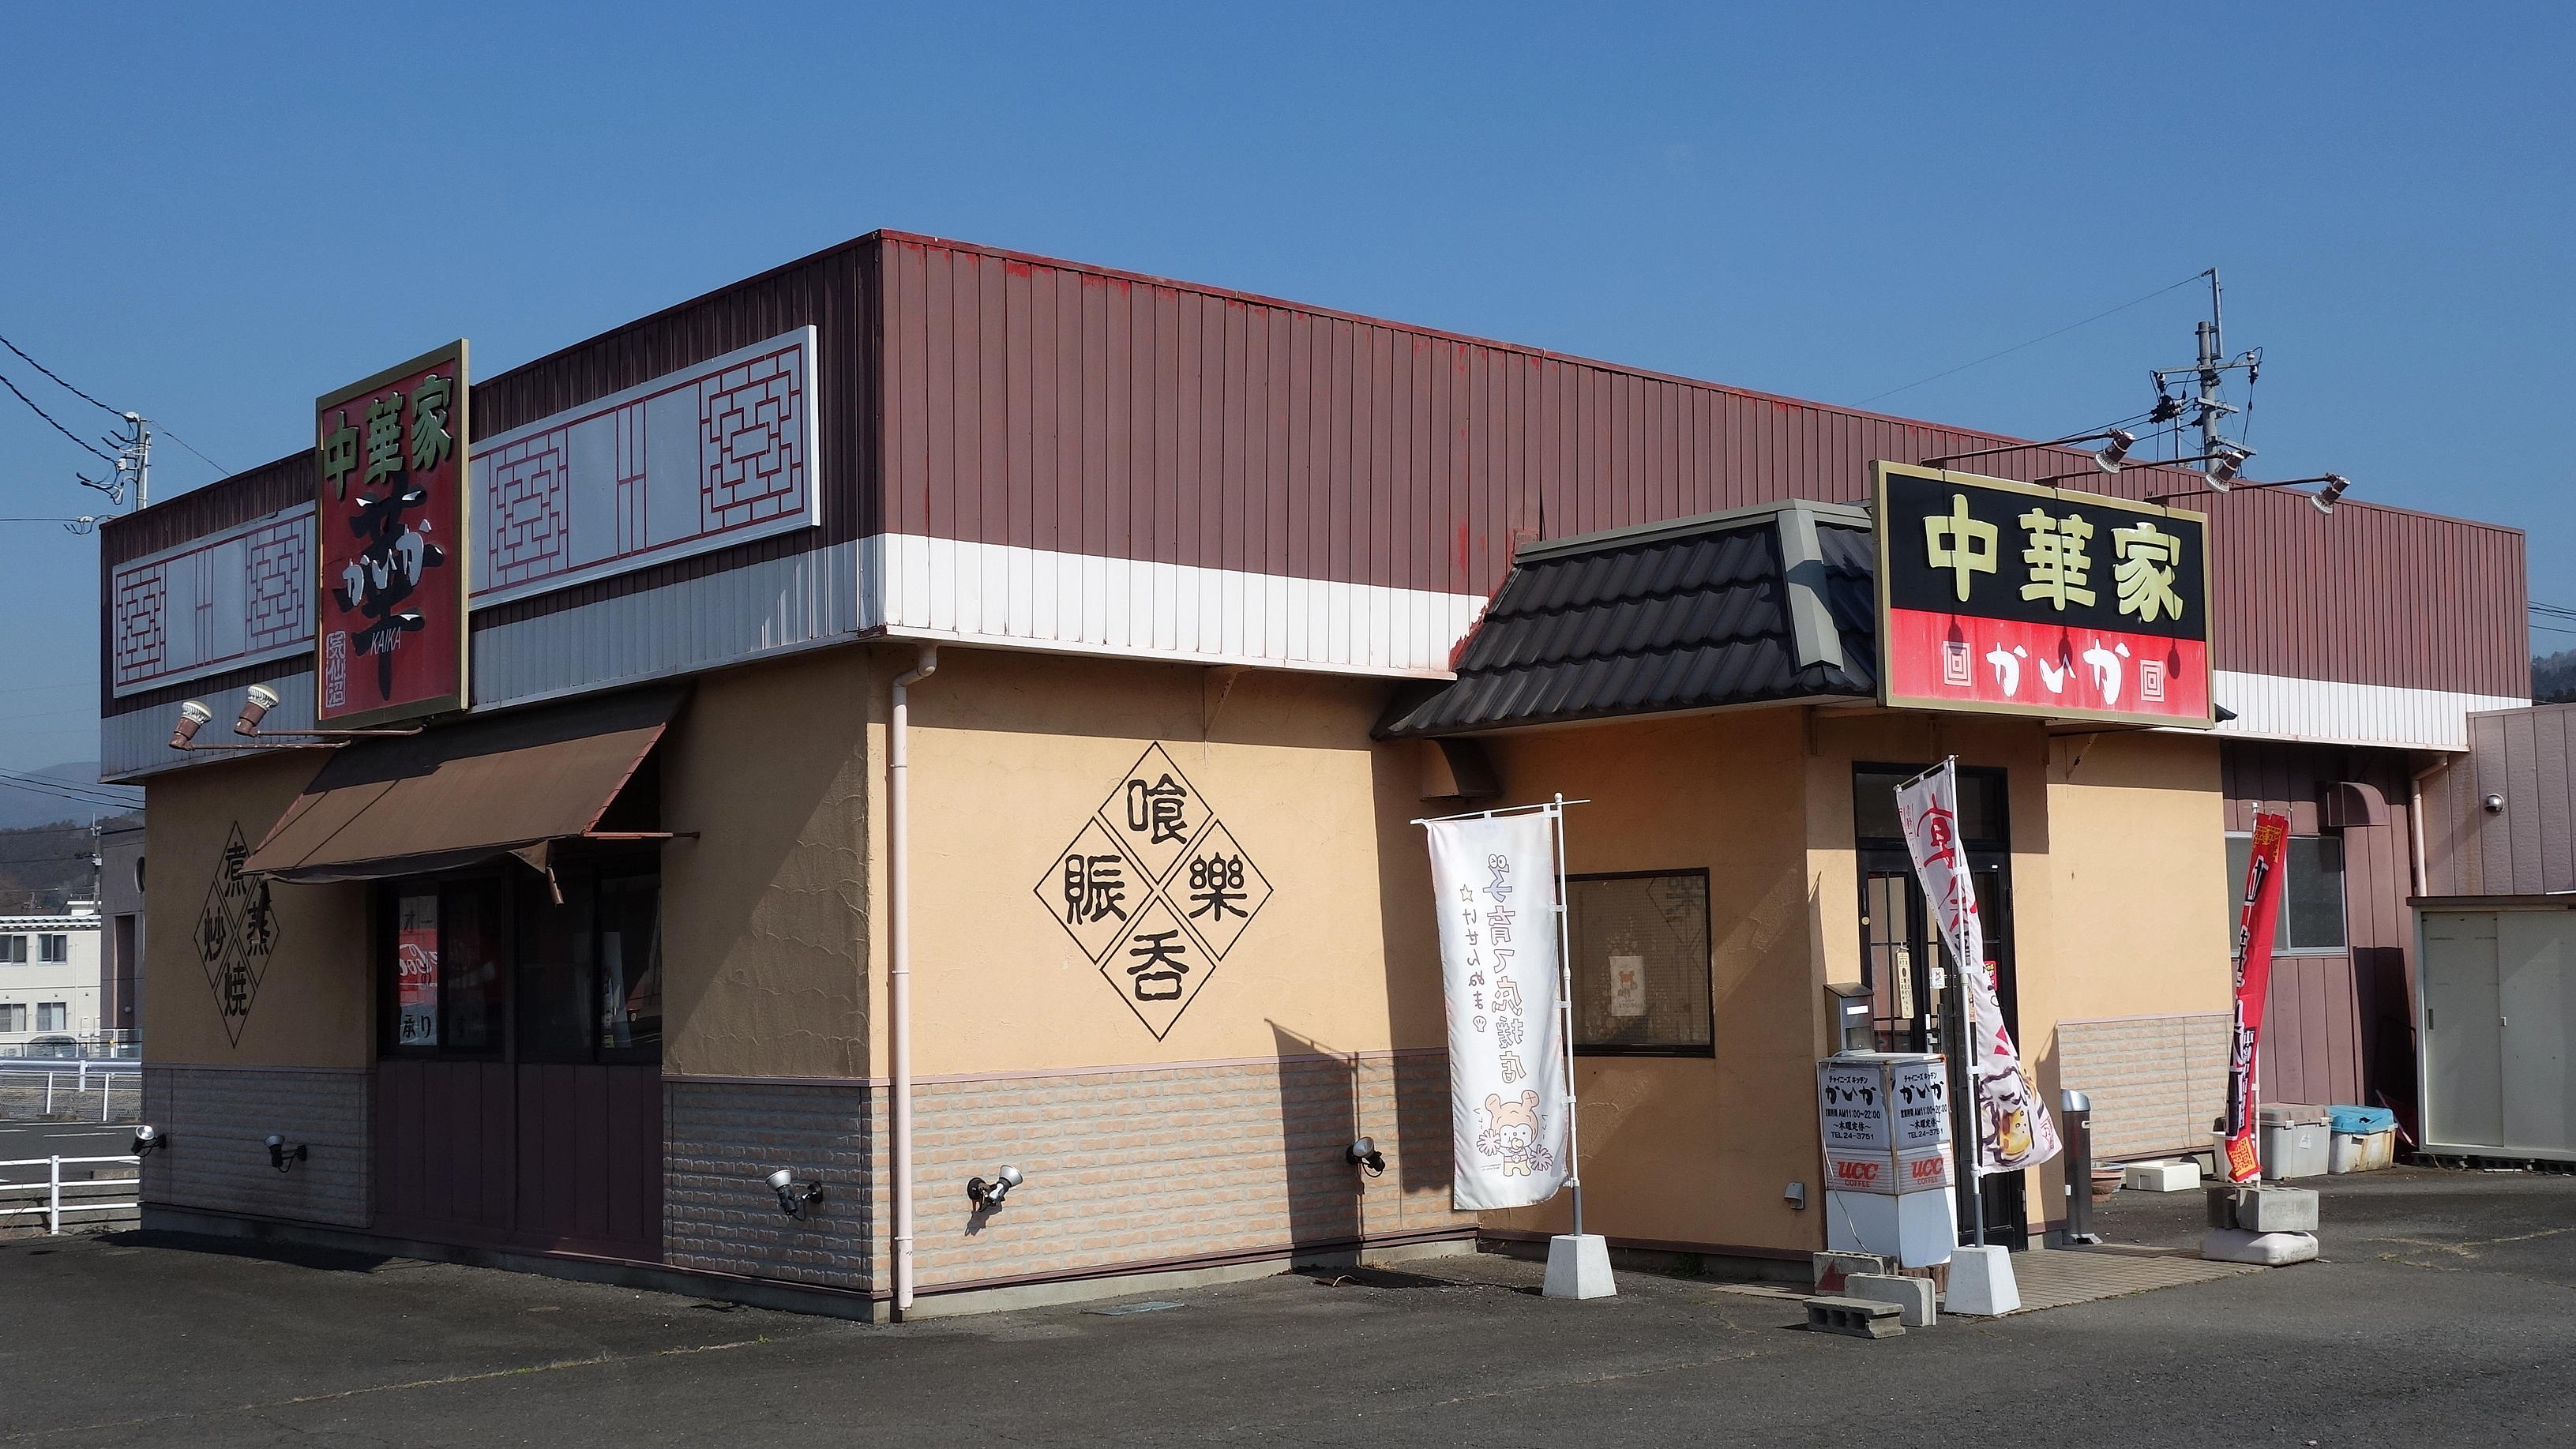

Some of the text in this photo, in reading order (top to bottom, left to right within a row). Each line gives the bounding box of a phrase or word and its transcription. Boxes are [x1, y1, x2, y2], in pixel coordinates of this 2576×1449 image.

[324, 374, 452, 500] 中華家
[342, 517, 432, 607] かいか
[1923, 494, 2184, 622] 中華家
[370, 626, 402, 656] KAIKA
[328, 633, 345, 706] 気仙沼
[1985, 638, 2131, 705] かいか
[1127, 773, 1188, 845] 喰
[1126, 929, 1189, 1001] 呑
[1825, 1084, 1877, 1106] かいか
[1899, 1080, 1944, 1105] かいか
[1837, 1162, 1879, 1181] UCC
[1845, 1179, 1871, 1188] COFFEE
[1910, 1157, 1944, 1178] UCC
[1917, 1176, 1939, 1185] COFFEE
